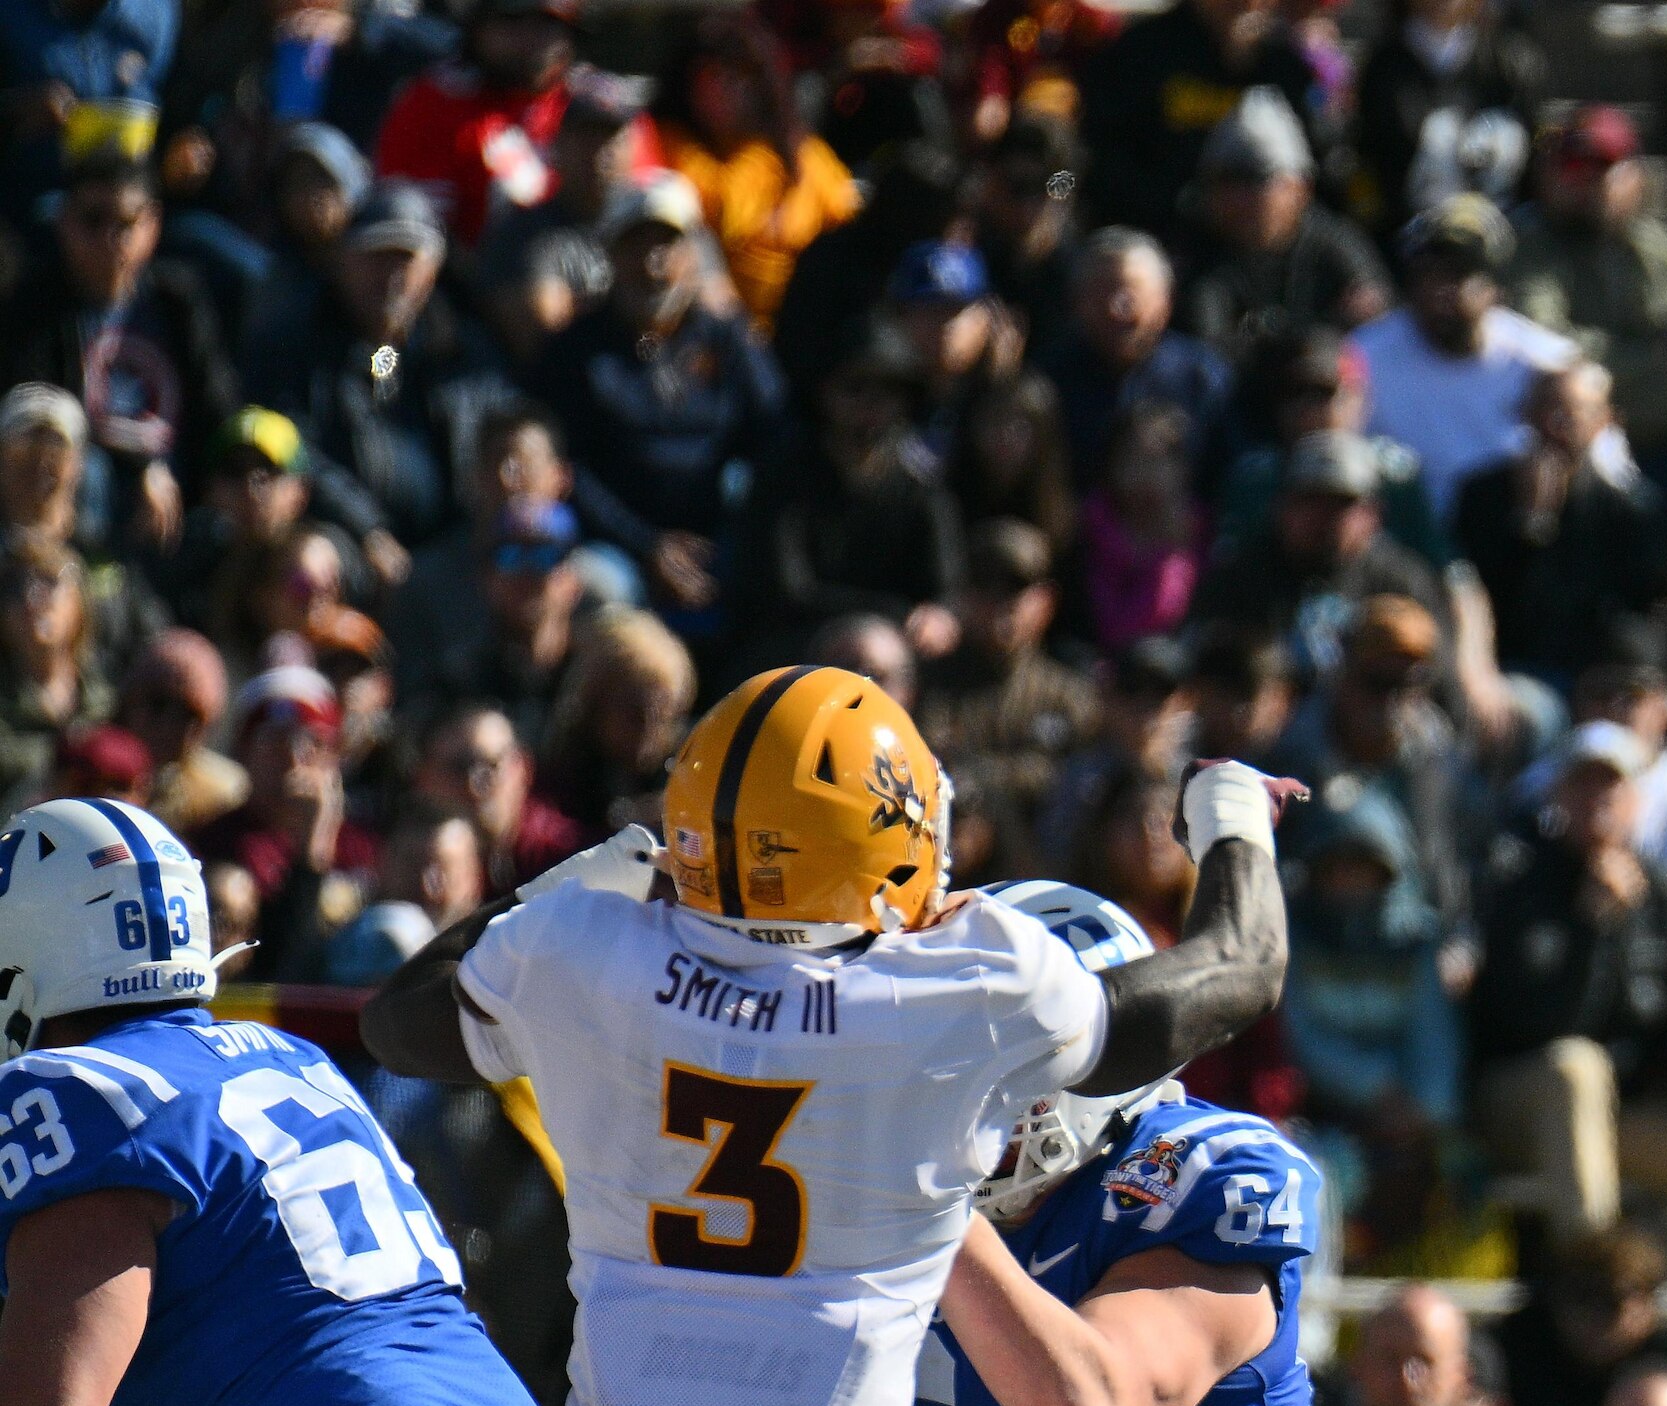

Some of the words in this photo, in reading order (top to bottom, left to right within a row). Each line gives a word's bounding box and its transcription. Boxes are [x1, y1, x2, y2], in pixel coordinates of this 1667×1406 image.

[748, 928, 811, 944] STATE
[103, 967, 161, 997] bull
[173, 970, 206, 993] city
[655, 952, 782, 1033] SMITH
[802, 978, 836, 1034] III
[647, 1057, 818, 1278] 3
[1213, 1168, 1304, 1246] 64
